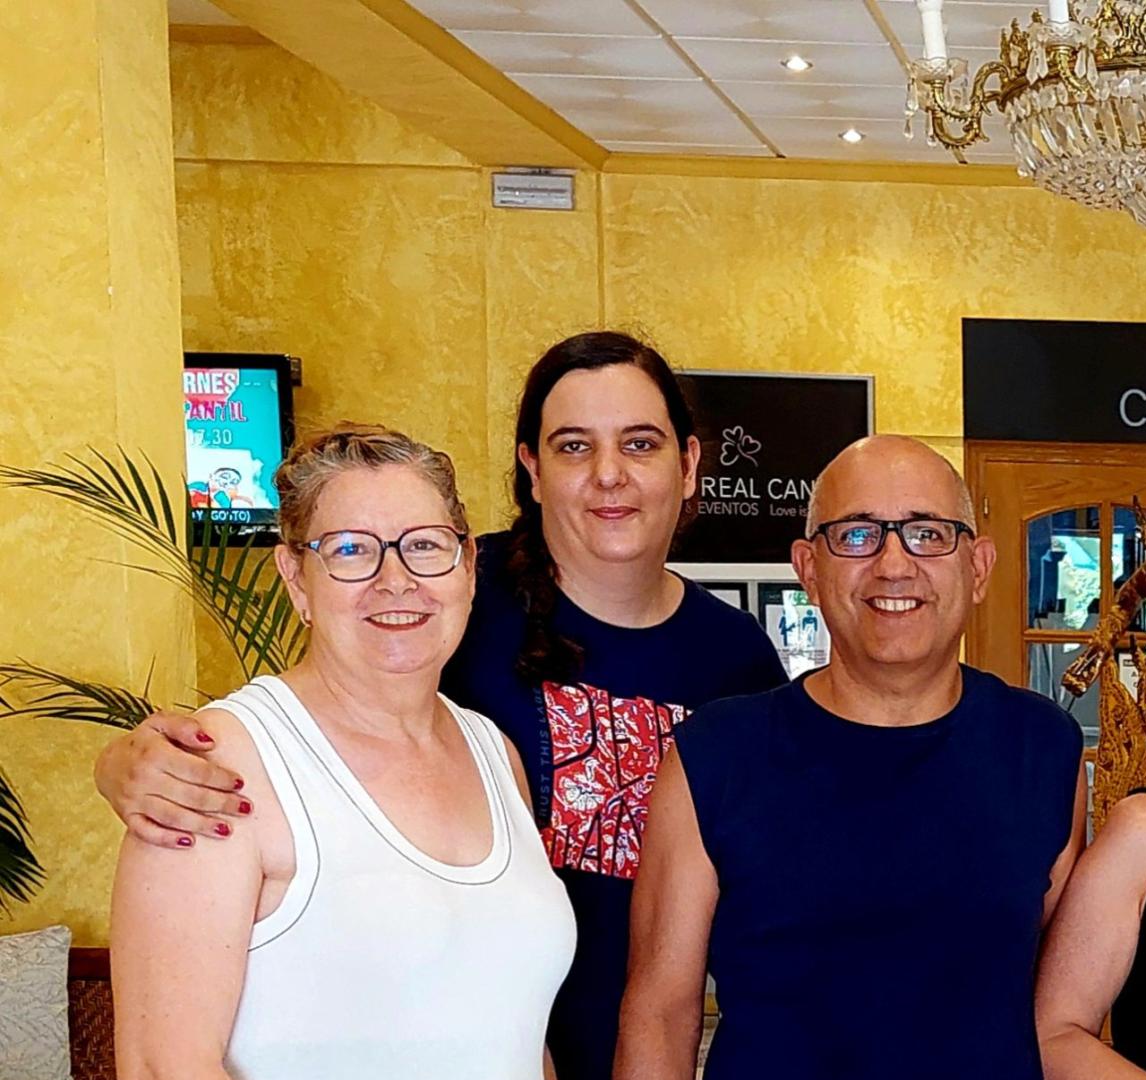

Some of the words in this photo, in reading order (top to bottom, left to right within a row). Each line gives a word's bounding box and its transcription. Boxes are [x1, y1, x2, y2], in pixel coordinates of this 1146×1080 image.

[701, 476, 761, 499] REAL
[698, 501, 759, 516] EVENTOS
[770, 504, 797, 517] Love
